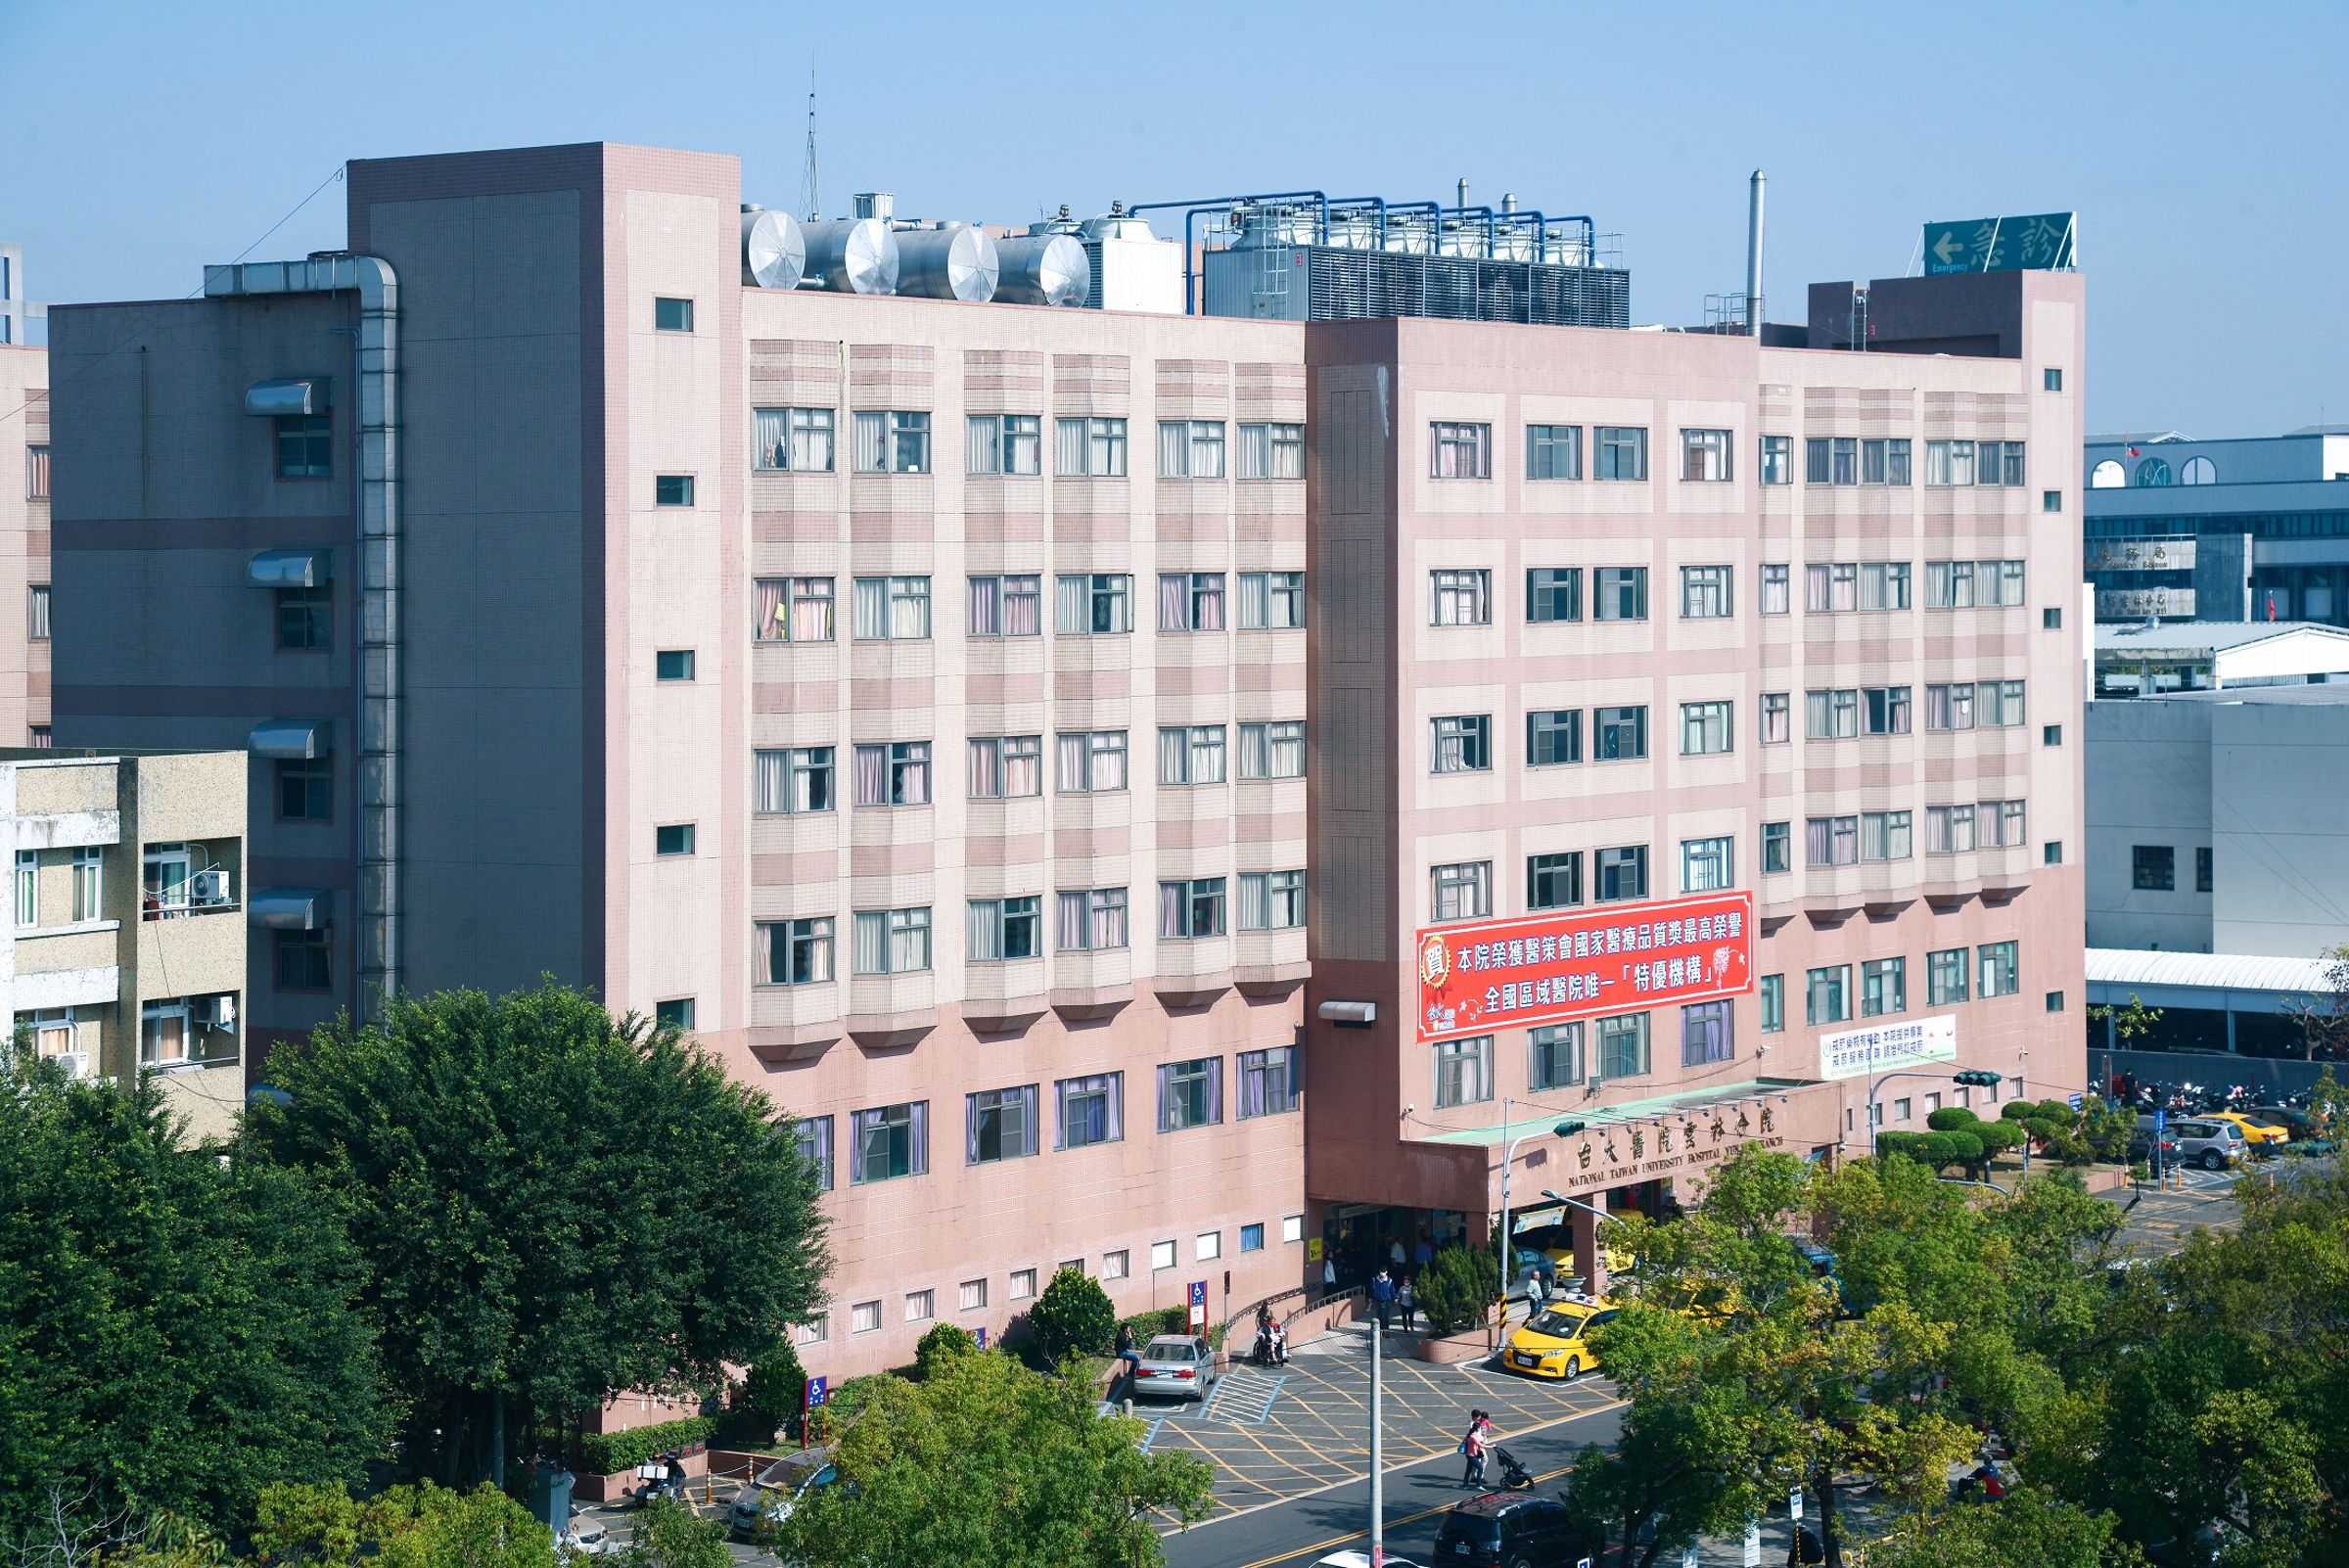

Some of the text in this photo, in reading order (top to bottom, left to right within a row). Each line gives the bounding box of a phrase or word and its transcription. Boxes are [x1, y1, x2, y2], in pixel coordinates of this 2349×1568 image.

[1970, 218, 2062, 267] 急診
[1932, 262, 1968, 273] Emergency
[1456, 911, 1742, 974] 本院榮獲醫策會國家醫療品質獎最高榮譽
[1425, 945, 1446, 980] 賀
[1568, 1172, 1605, 1187] NATIONAL
[1610, 1165, 1638, 1179] TAIWAN
[1641, 1155, 1684, 1174] UNIVERSITY
[1687, 1148, 1721, 1164] HOSPITAL
